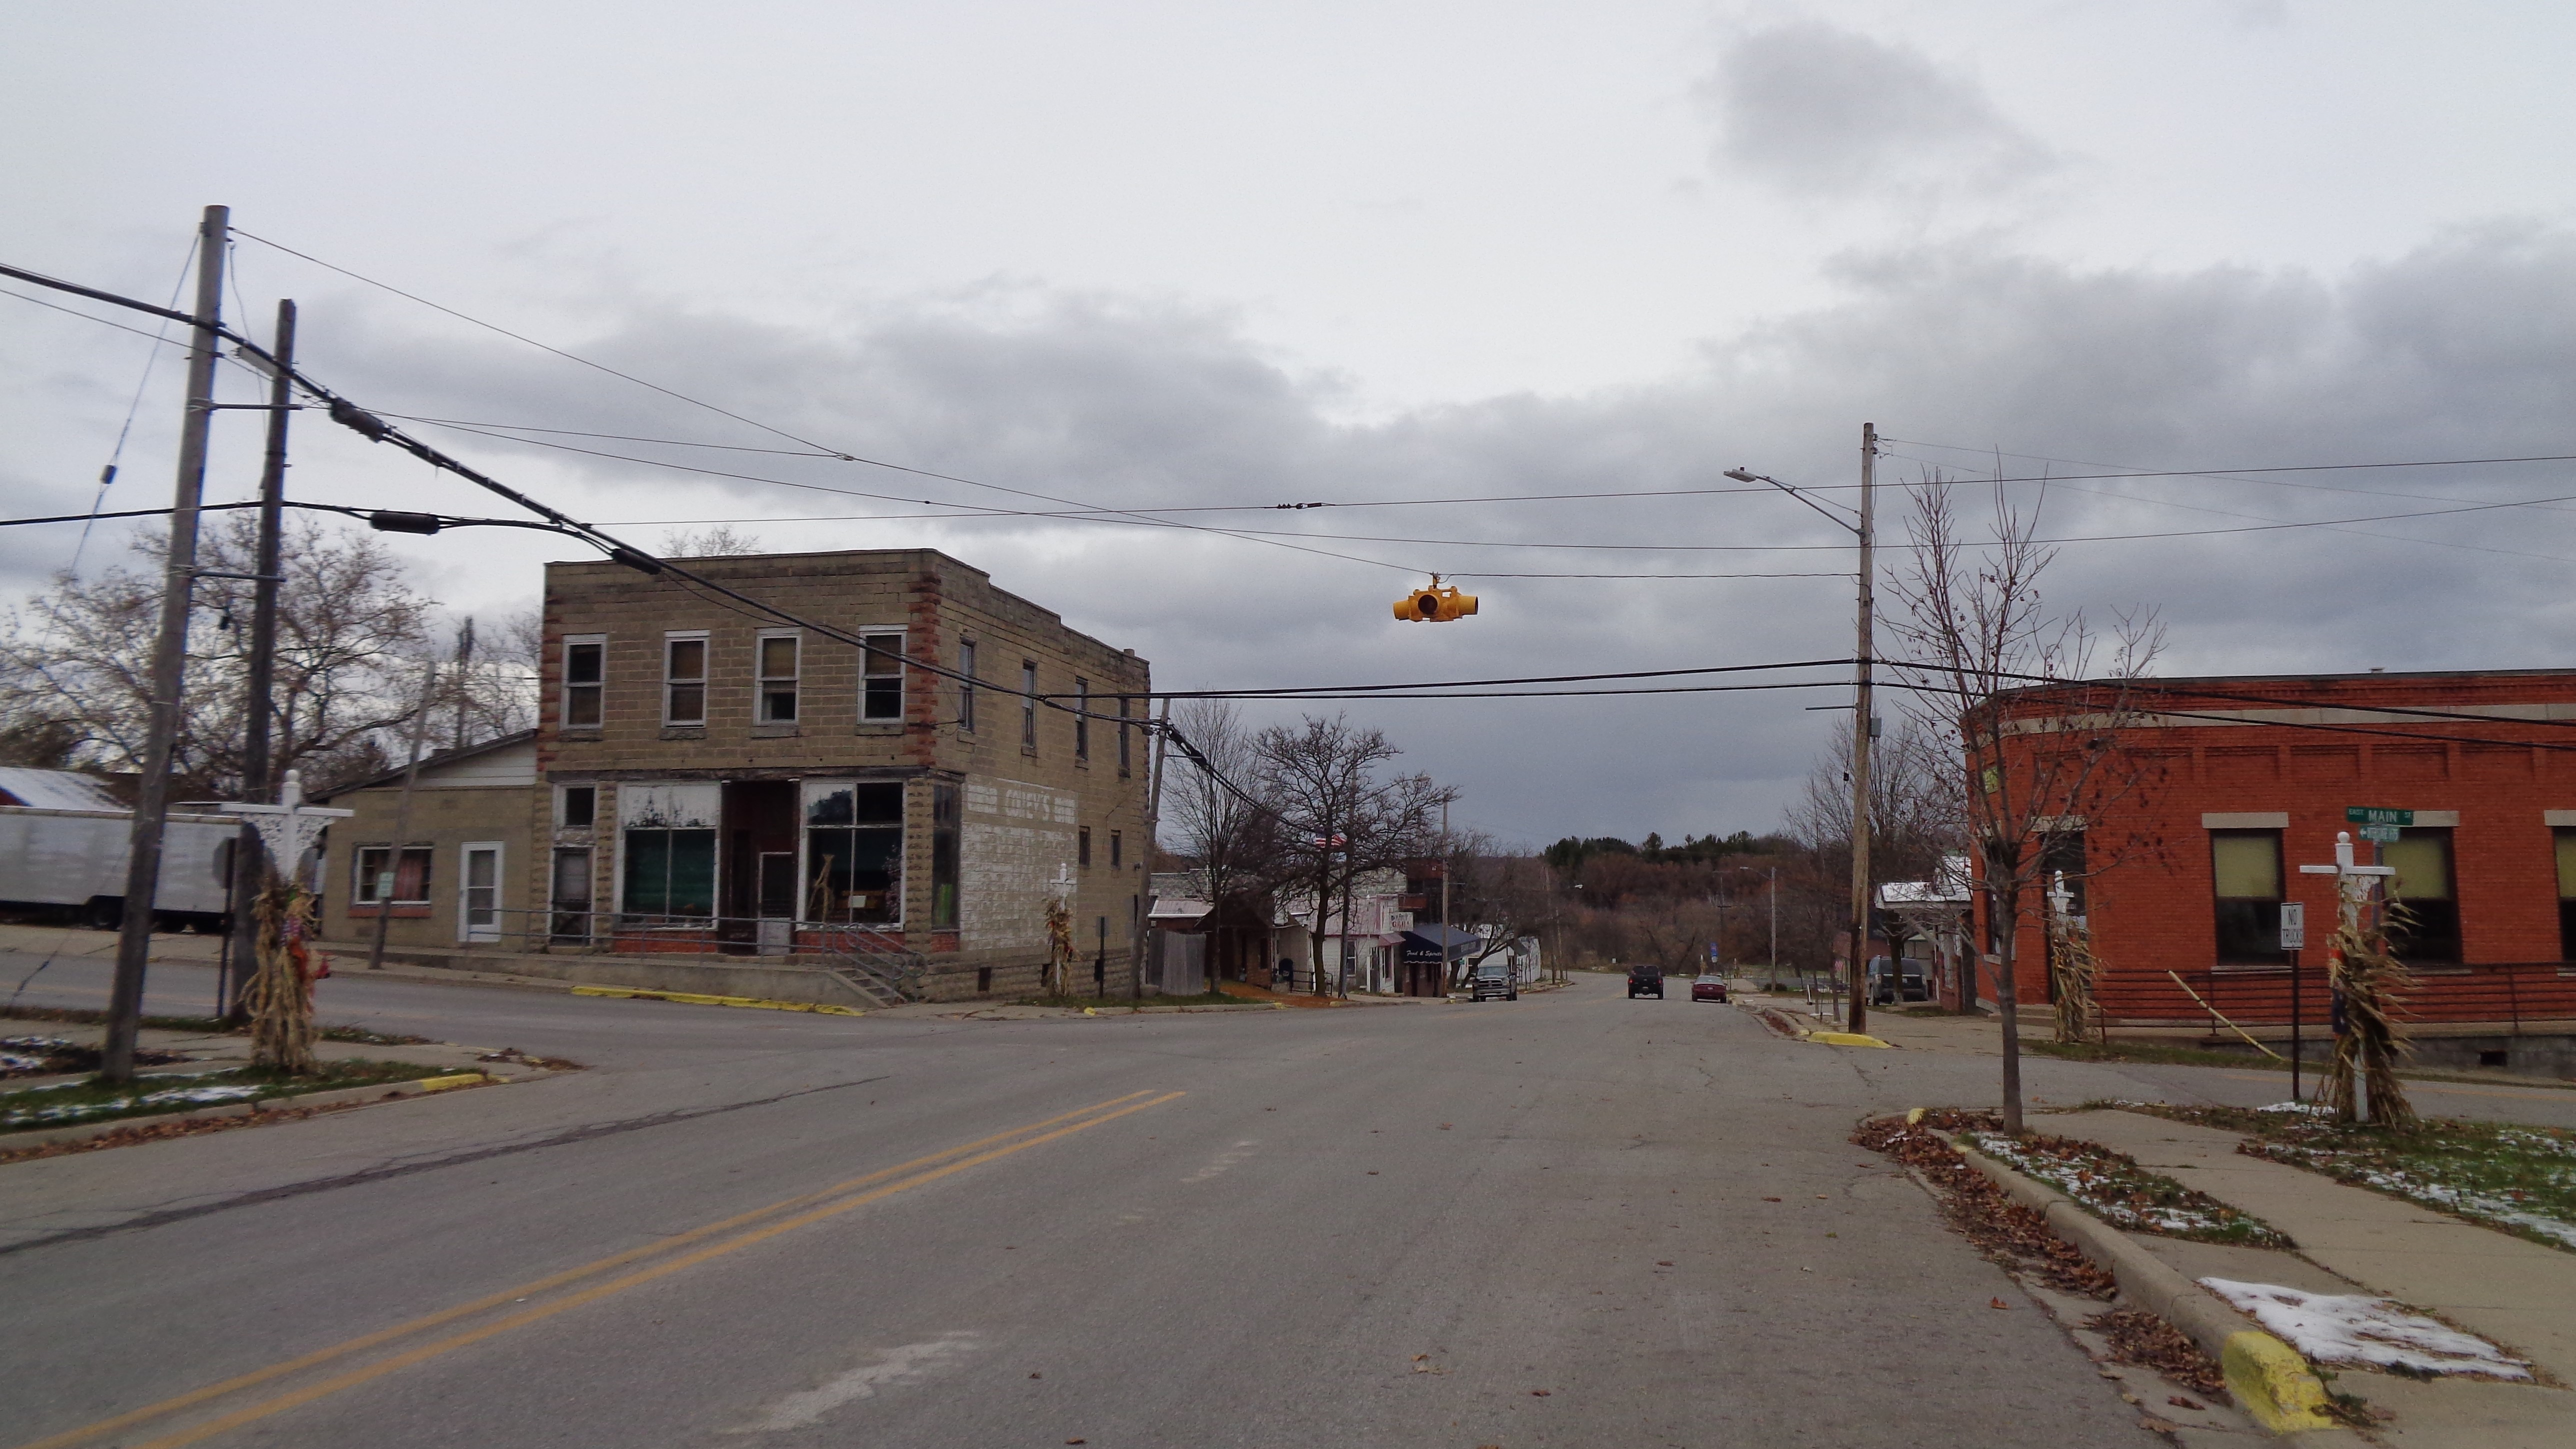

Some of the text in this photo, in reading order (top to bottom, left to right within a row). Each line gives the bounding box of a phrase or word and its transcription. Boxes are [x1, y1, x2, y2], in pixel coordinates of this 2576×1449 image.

[2368, 810, 2397, 822] MAIN
[2288, 908, 2296, 925] NO
[2282, 928, 2302, 943] TRUCKS
